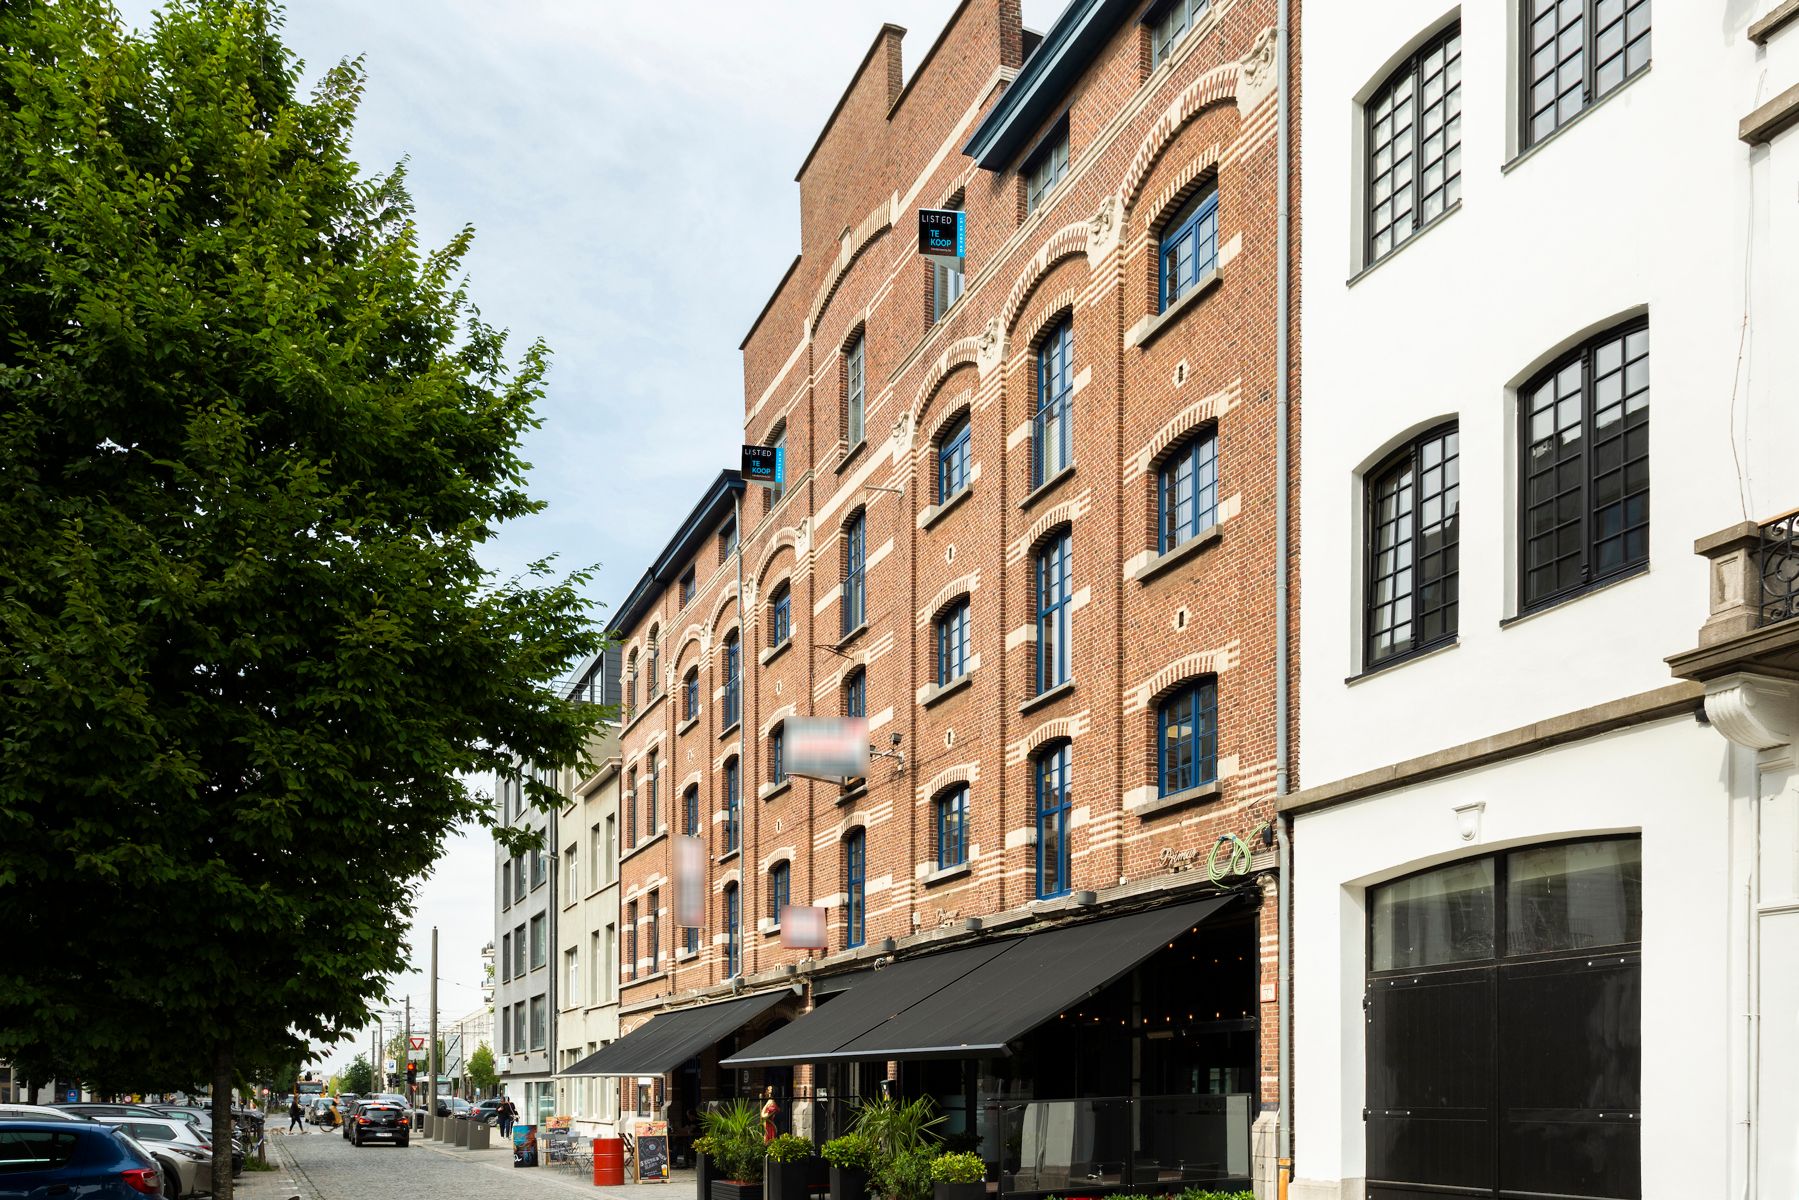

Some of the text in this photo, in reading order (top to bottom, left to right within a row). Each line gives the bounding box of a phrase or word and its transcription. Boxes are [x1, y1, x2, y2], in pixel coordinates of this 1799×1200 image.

[921, 214, 952, 225] LISTED
[930, 229, 940, 238] TE
[930, 238, 952, 247] KOOP
[744, 448, 772, 457] LISTED
[752, 467, 771, 475] KOOP
